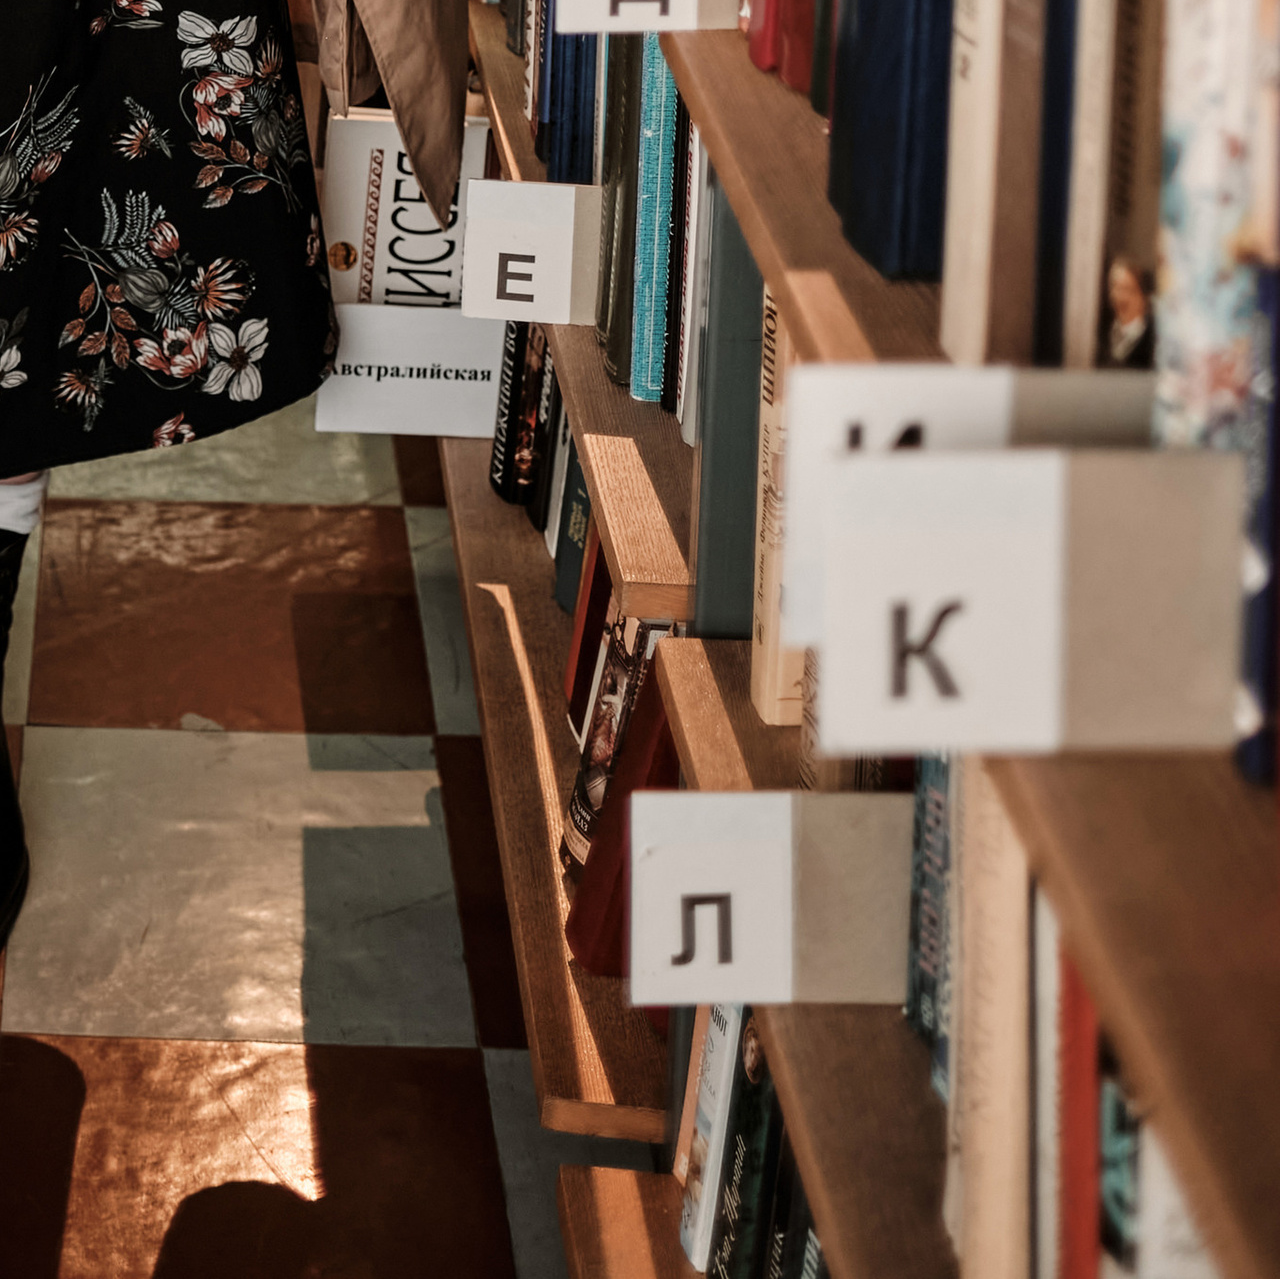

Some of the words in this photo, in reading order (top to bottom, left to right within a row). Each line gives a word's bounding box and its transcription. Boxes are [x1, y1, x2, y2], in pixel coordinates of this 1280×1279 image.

[495, 251, 536, 303] Е
[761, 292, 779, 407] ШПИОН
[886, 596, 966, 700] К
[669, 890, 734, 966] Л
